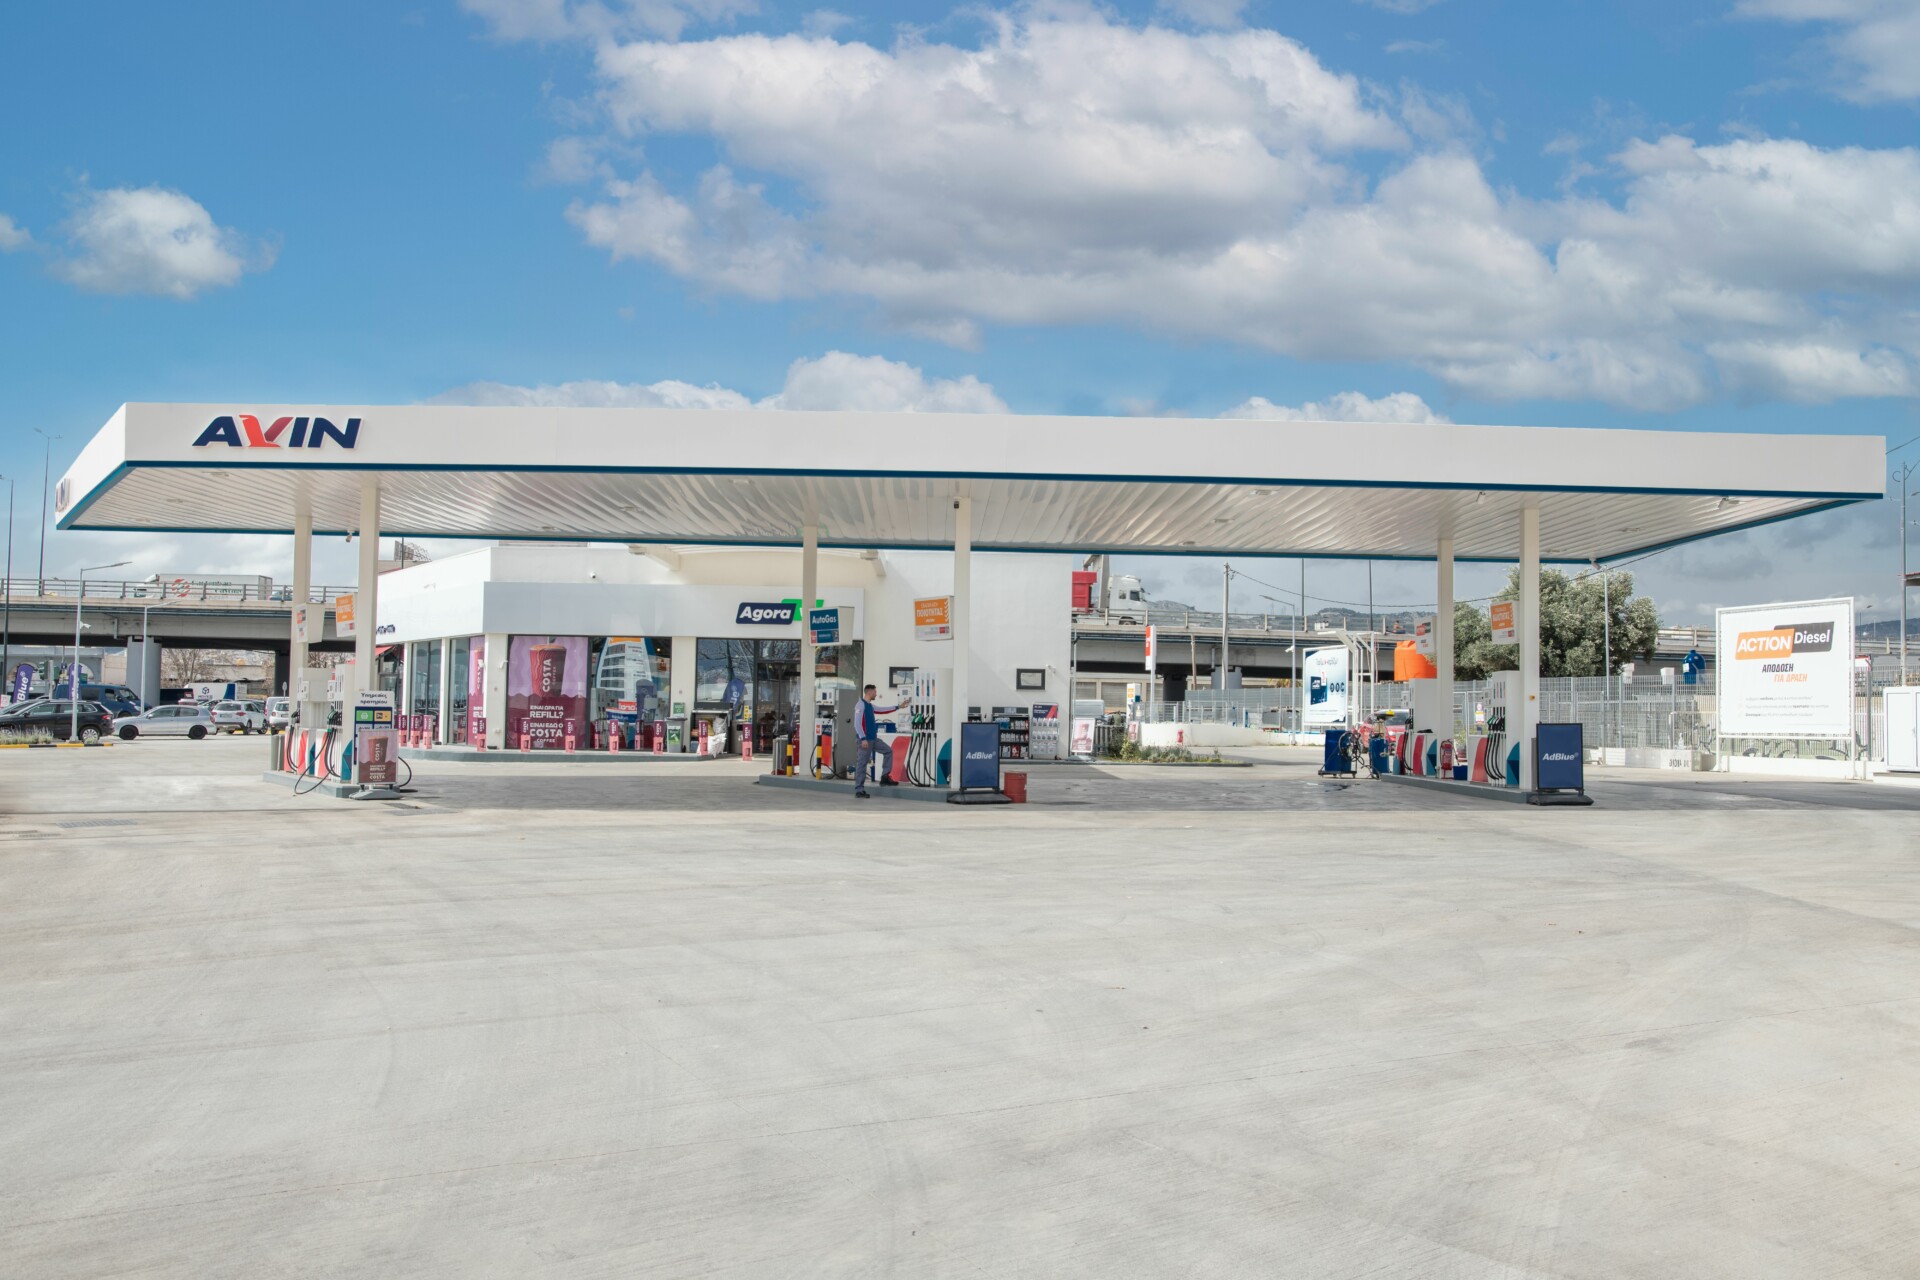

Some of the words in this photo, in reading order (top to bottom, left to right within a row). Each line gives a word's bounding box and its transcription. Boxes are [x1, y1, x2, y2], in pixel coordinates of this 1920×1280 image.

[192, 414, 362, 449] AVIN
[739, 606, 792, 621] Agora
[812, 614, 837, 624] AutoGas
[1737, 636, 1792, 653] ACTION
[1793, 629, 1831, 644] Diesel
[1762, 664, 1794, 673] ΑΠΟΔΟΣΗ
[542, 658, 552, 693] COSTA
[1774, 674, 1784, 683] ΓΙΑ
[1786, 674, 1808, 683] ΔΡΑΣΗ
[530, 729, 563, 737] COSTA
